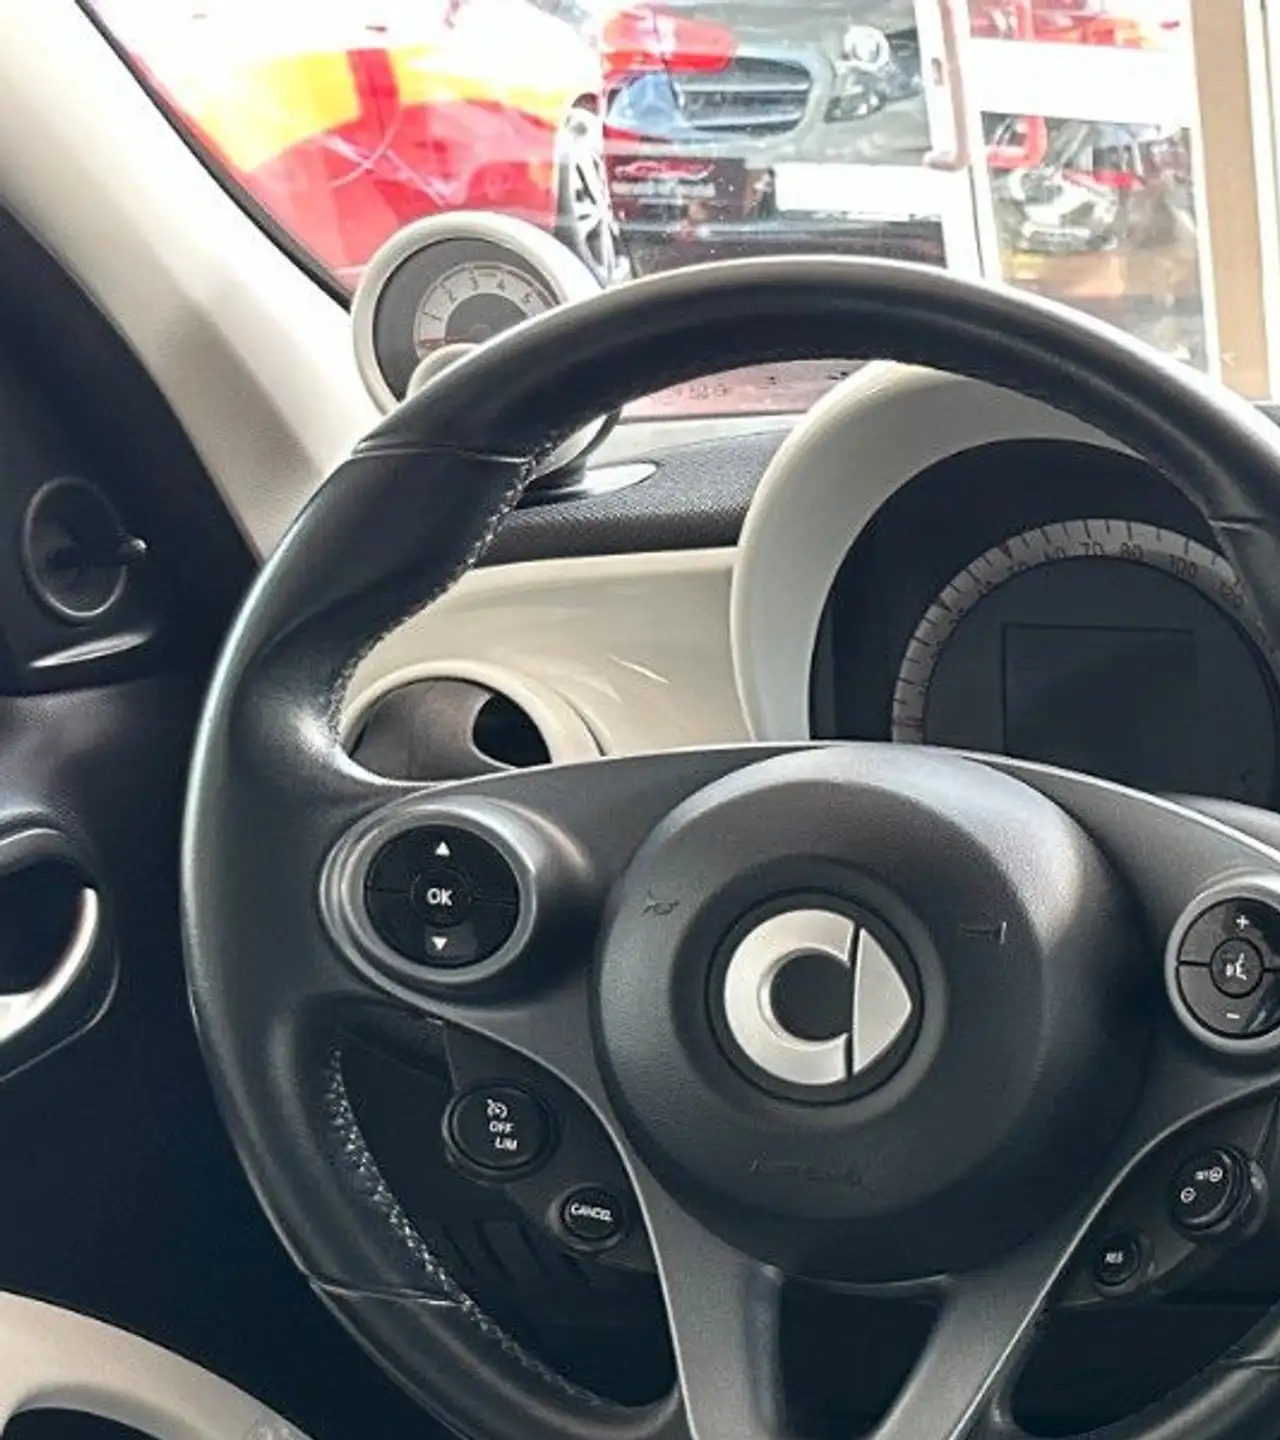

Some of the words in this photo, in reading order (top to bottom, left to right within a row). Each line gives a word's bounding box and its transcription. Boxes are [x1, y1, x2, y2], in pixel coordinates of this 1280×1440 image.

[1168, 553, 1198, 579] 100
[426, 887, 454, 907] OK
[488, 1119, 515, 1134] OFF
[494, 1136, 518, 1150] LIM
[571, 1202, 614, 1223] CANCEL
